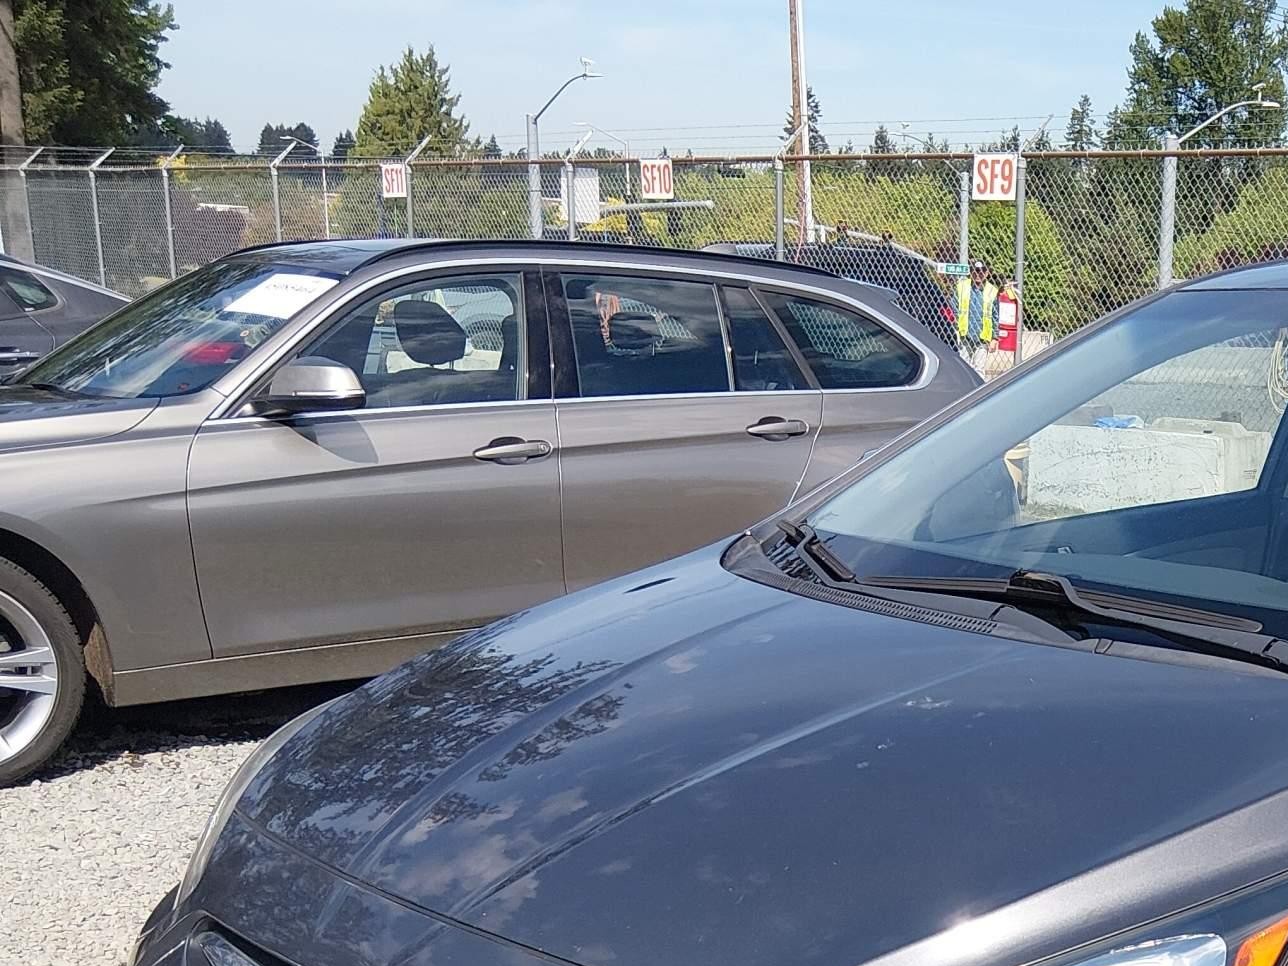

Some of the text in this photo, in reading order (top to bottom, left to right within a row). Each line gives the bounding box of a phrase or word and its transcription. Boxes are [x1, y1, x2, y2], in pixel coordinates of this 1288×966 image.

[384, 167, 404, 193] SF11
[642, 163, 672, 194] SF10
[976, 158, 1014, 195] SF9
